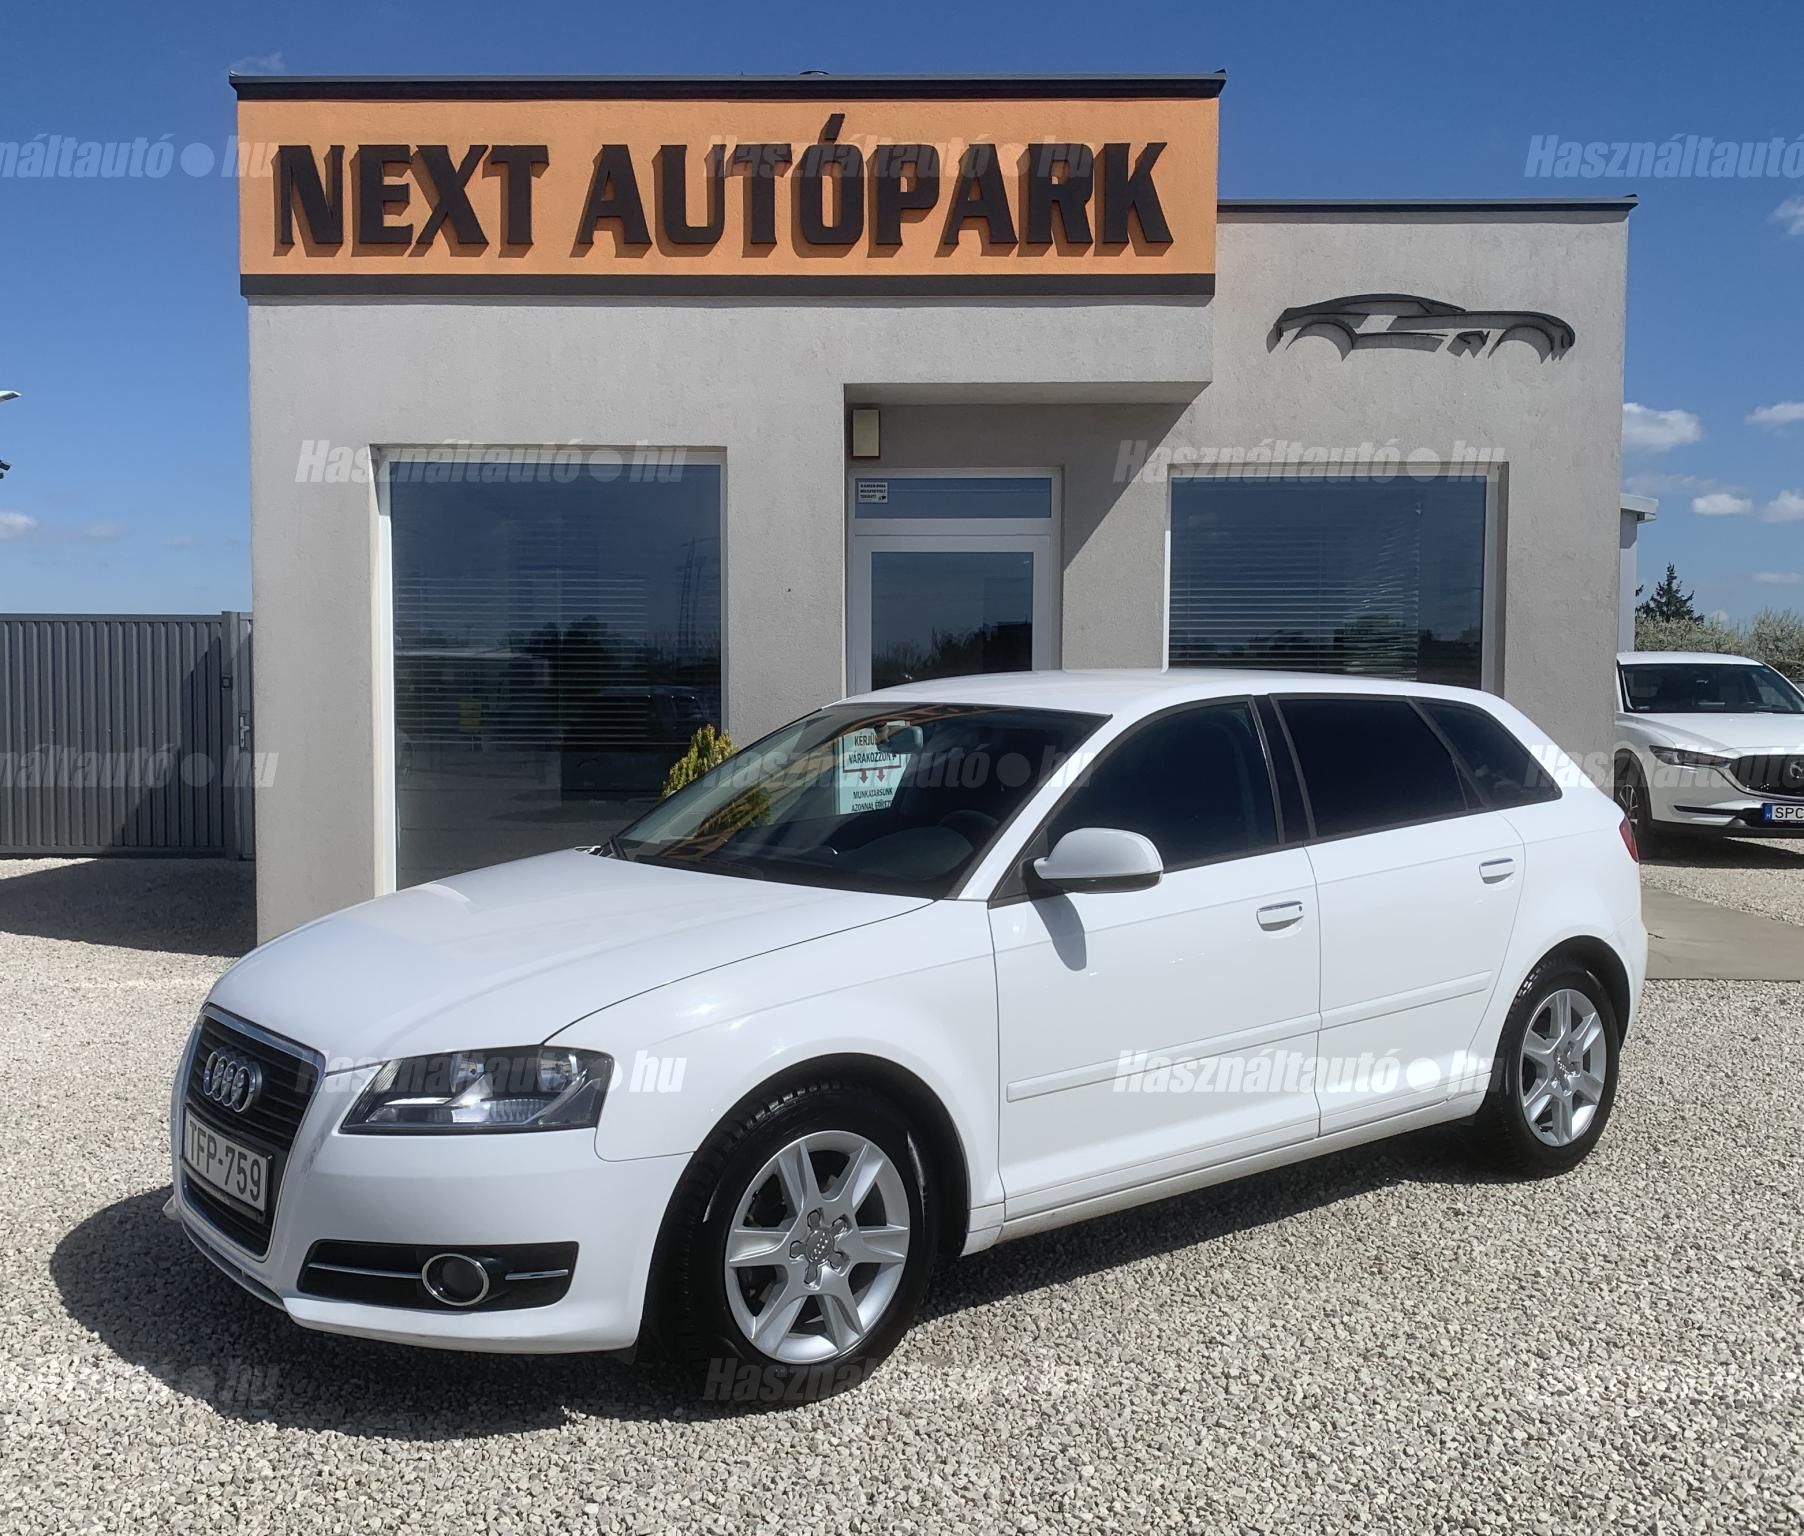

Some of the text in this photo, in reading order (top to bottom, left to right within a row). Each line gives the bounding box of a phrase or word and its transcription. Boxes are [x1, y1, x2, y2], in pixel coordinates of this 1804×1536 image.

[278, 113, 1174, 246] NEXT AUTÓPARK
[189, 1120, 261, 1202] TFP-759
